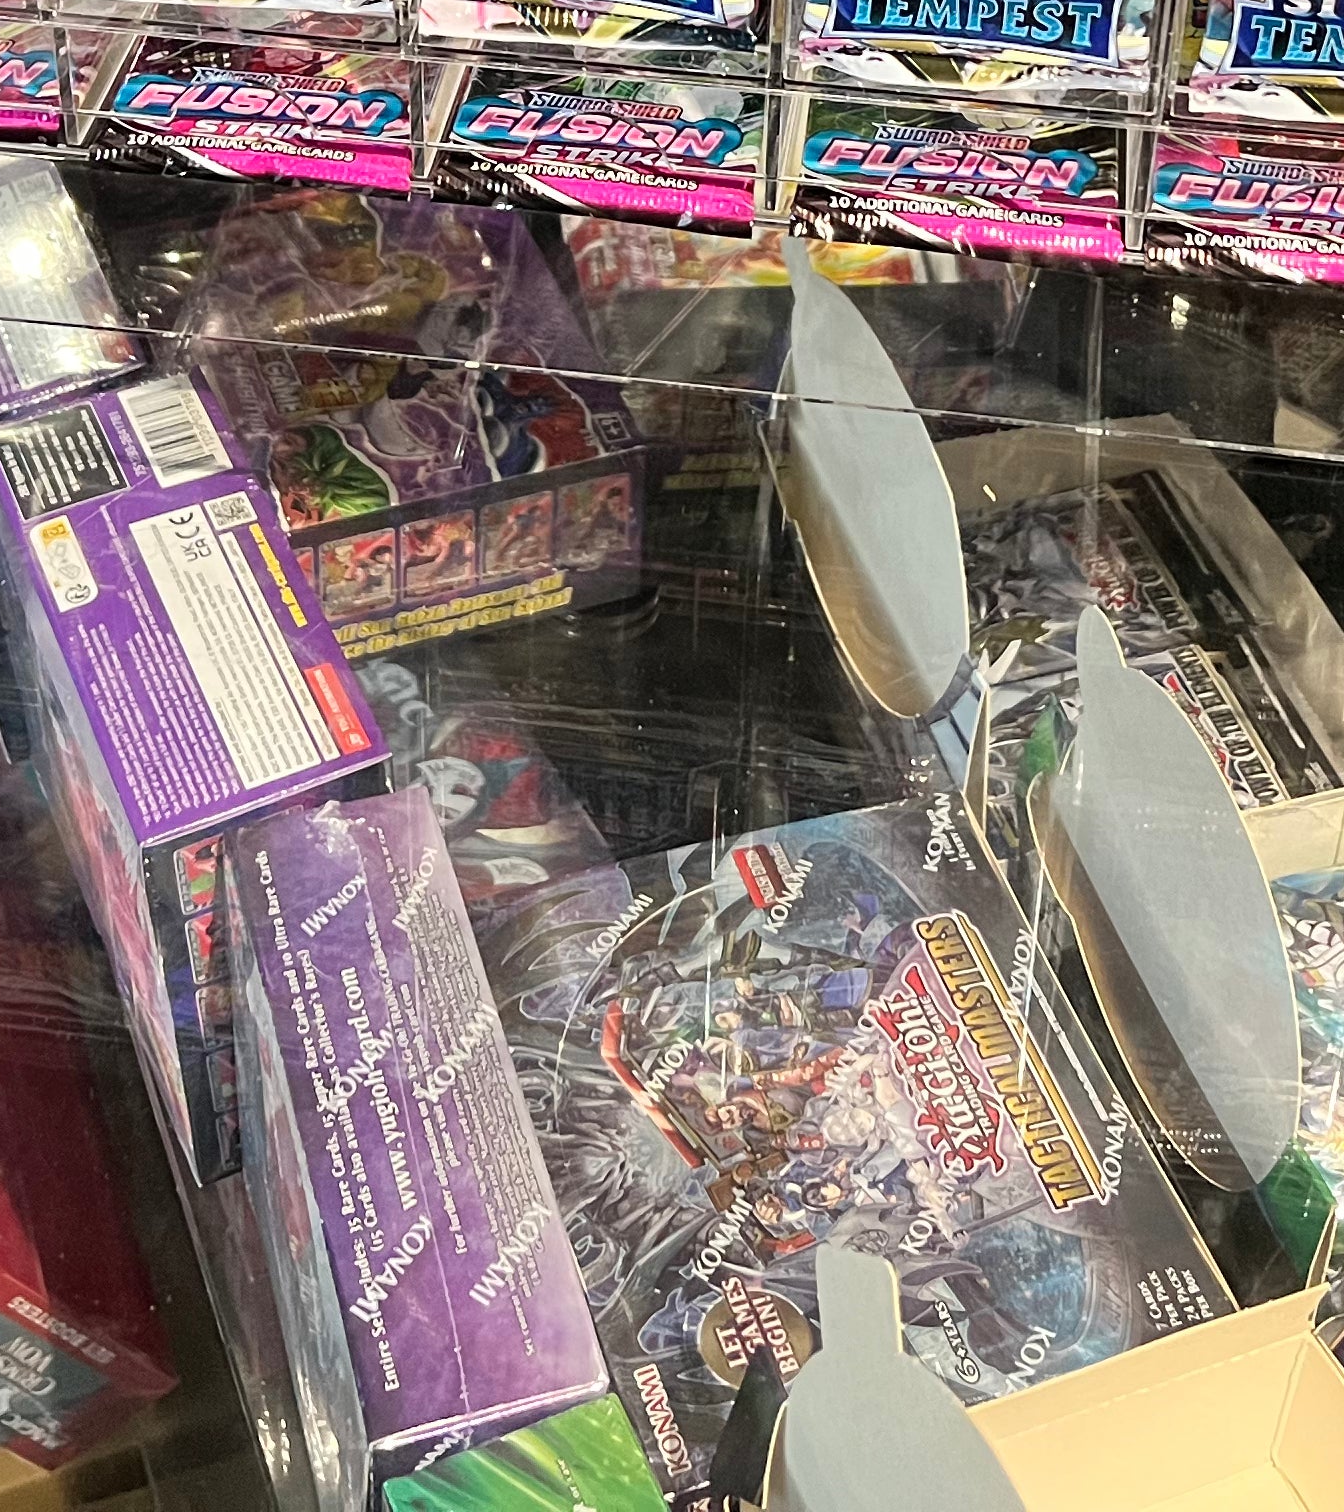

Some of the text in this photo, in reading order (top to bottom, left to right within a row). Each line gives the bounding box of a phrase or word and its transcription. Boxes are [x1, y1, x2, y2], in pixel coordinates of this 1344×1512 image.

[129, 79, 384, 131] FUSION
[128, 132, 147, 146] 10
[151, 133, 249, 153] ADDITIONAL
[191, 117, 336, 143] STRIK
[469, 106, 723, 154] FUSION
[469, 161, 490, 172] 10
[494, 163, 589, 179] ADDITIONAL
[819, 138, 1078, 188] FUSION
[829, 196, 851, 208] 10
[853, 197, 953, 215] ADDITIONAL
[889, 177, 1042, 201] STRIKE
[1183, 234, 1207, 246] 10
[1209, 234, 1310, 253] ADDITIONAL
[253, 849, 275, 885] Cards
[262, 885, 282, 915] Rare
[302, 873, 368, 939] KONAMI
[762, 857, 815, 935] KONAMI
[269, 916, 290, 950] Ultra
[586, 892, 655, 958] KONAMI
[283, 967, 302, 993] and
[295, 946, 320, 989] Rares)
[914, 906, 1017, 1061] MASTERS
[289, 995, 312, 1035] Cards
[305, 990, 337, 1063] Collector's
[299, 1036, 321, 1069] Rare
[917, 992, 997, 1136] TRADING CARD GAME
[985, 1049, 1093, 1210] TACTICAL
[347, 1152, 368, 1182] also
[335, 1179, 357, 1214] Rare
[355, 1185, 379, 1227] Cards
[692, 1198, 752, 1283] KONAMI
[348, 1213, 434, 1324] KONAMI
[5, 1293, 87, 1350] BOOSTERS
[752, 1292, 799, 1374] BEGIN!
[932, 1297, 963, 1347] YEARS
[1155, 1320, 1169, 1330] 7
[1183, 1304, 1200, 1322] 24
[374, 1339, 399, 1390] Entire
[714, 1322, 749, 1370] LET
[631, 1363, 693, 1475] KONAMI
